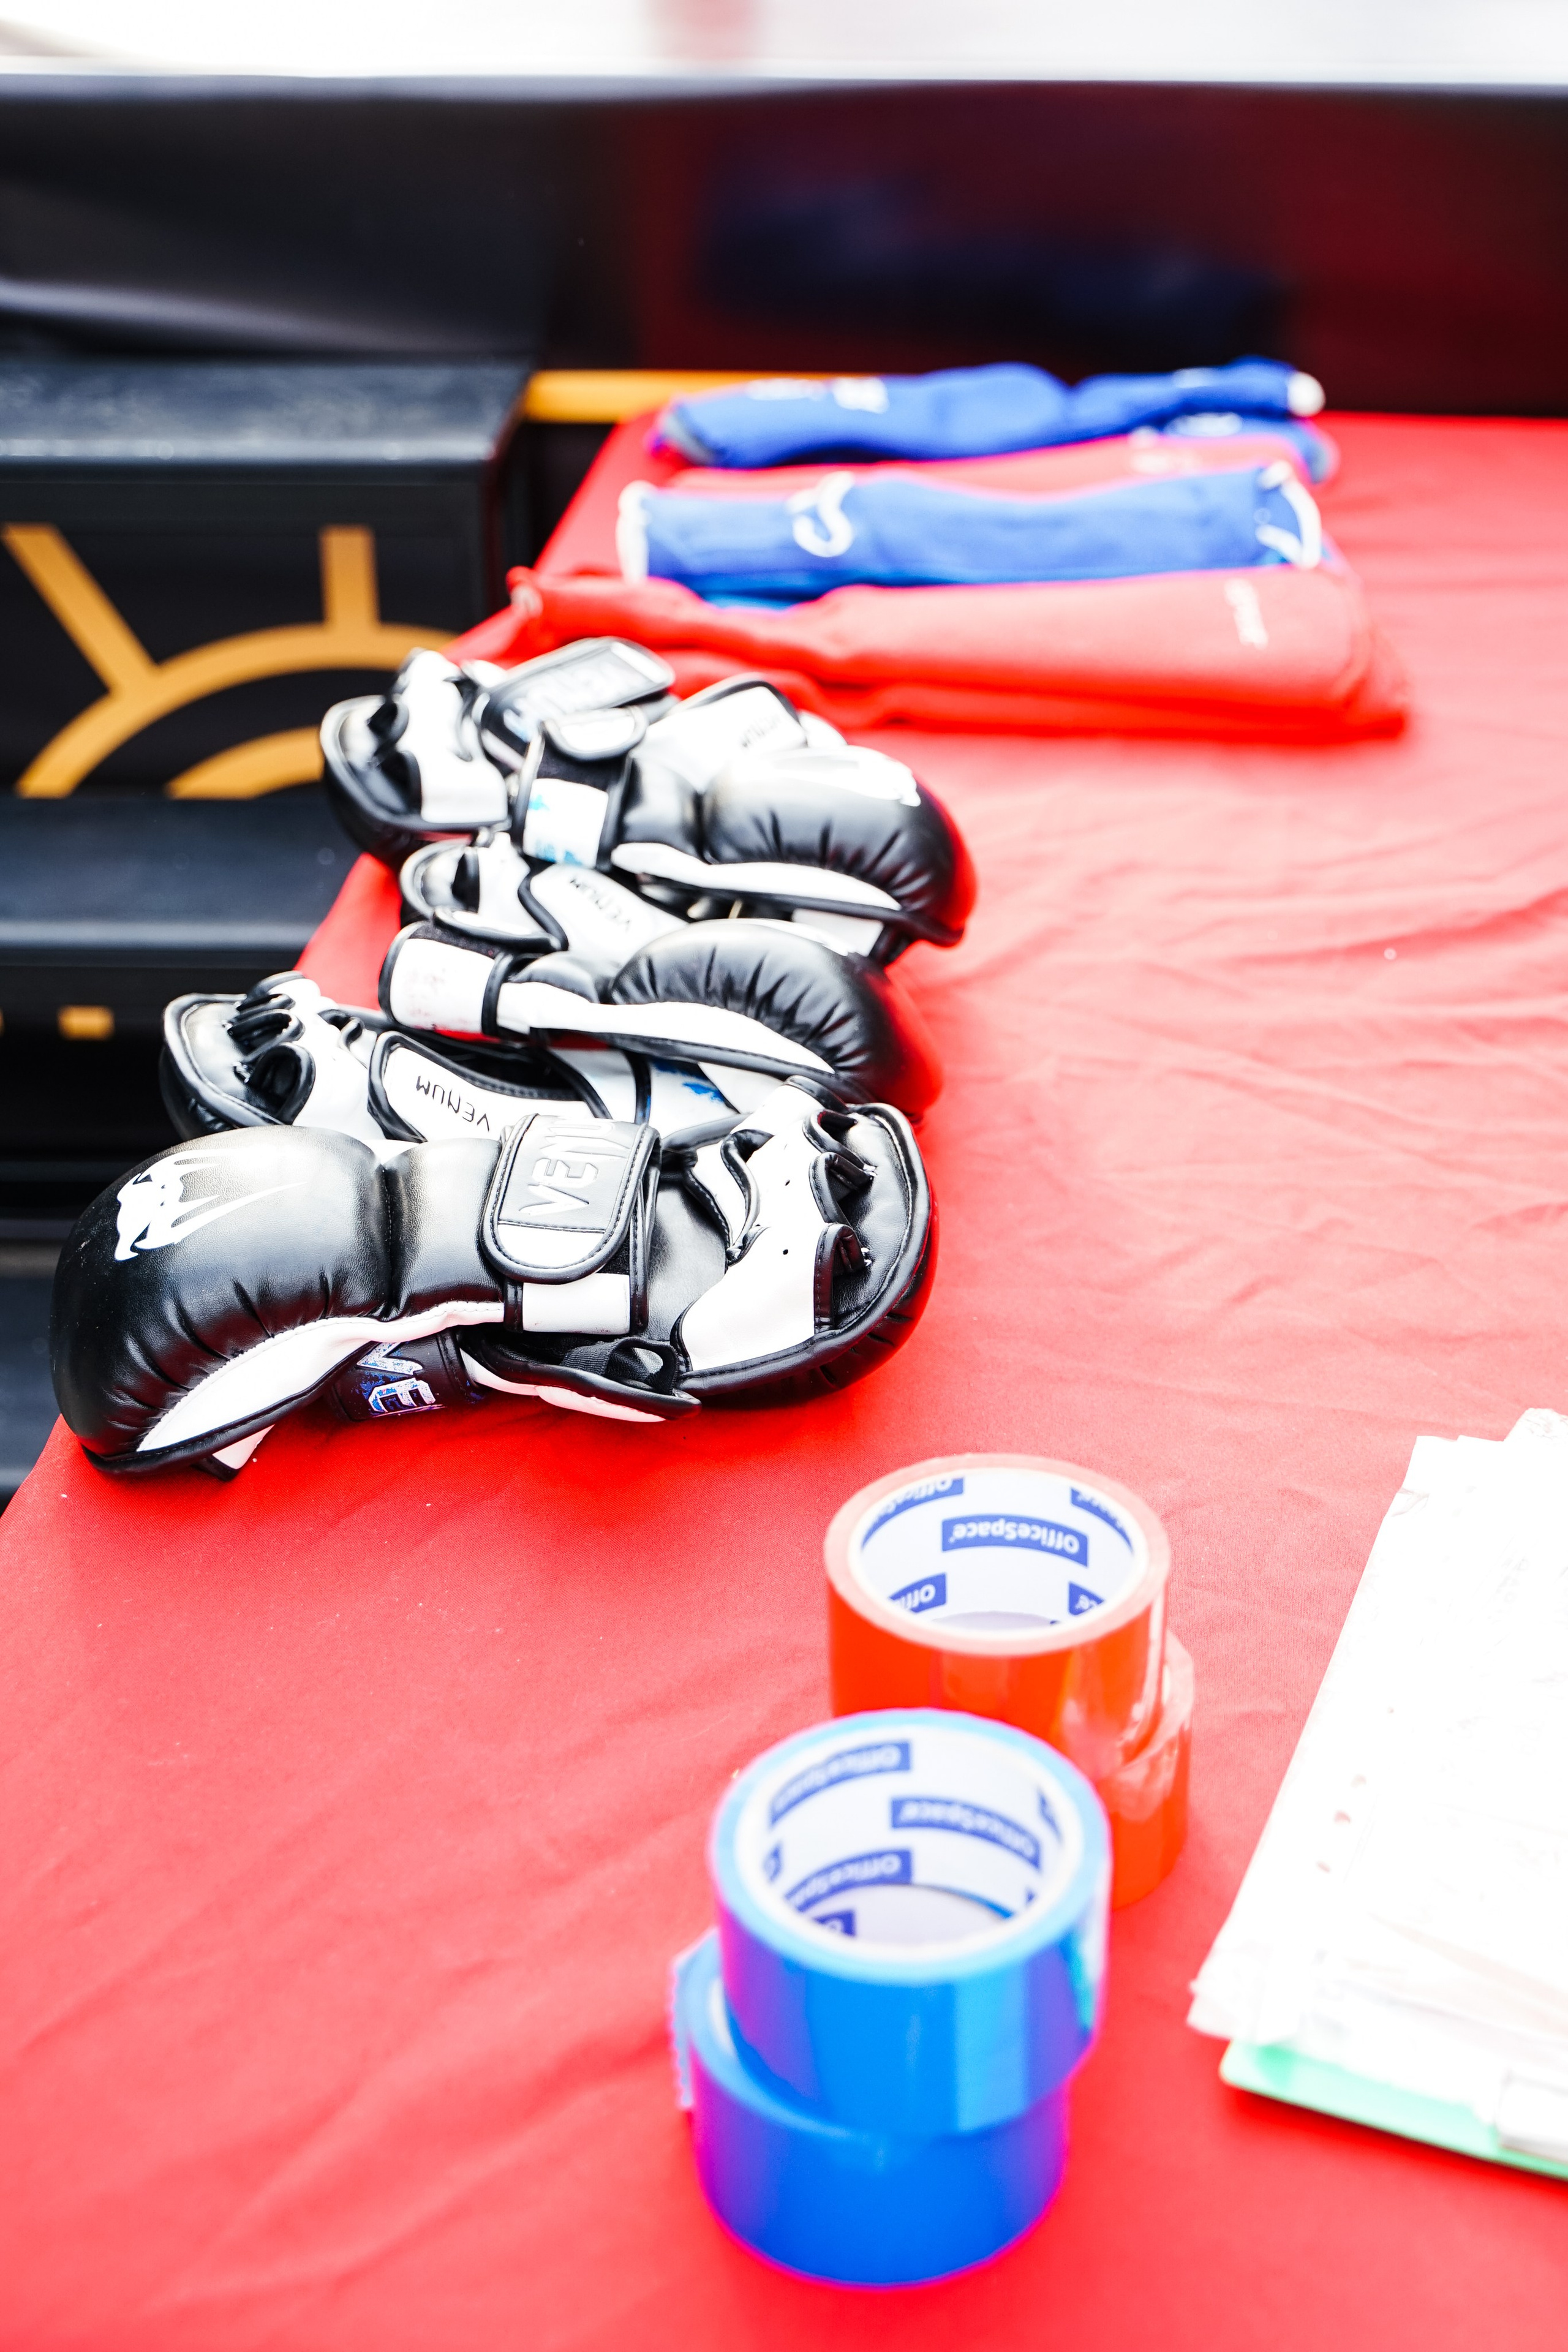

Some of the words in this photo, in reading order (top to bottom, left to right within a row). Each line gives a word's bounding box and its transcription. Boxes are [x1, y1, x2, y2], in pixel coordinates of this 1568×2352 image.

[416, 1076, 489, 1132] VENUM
[519, 1118, 628, 1215] VENU
[357, 1341, 435, 1413] VE
[900, 1583, 936, 1610] Offi
